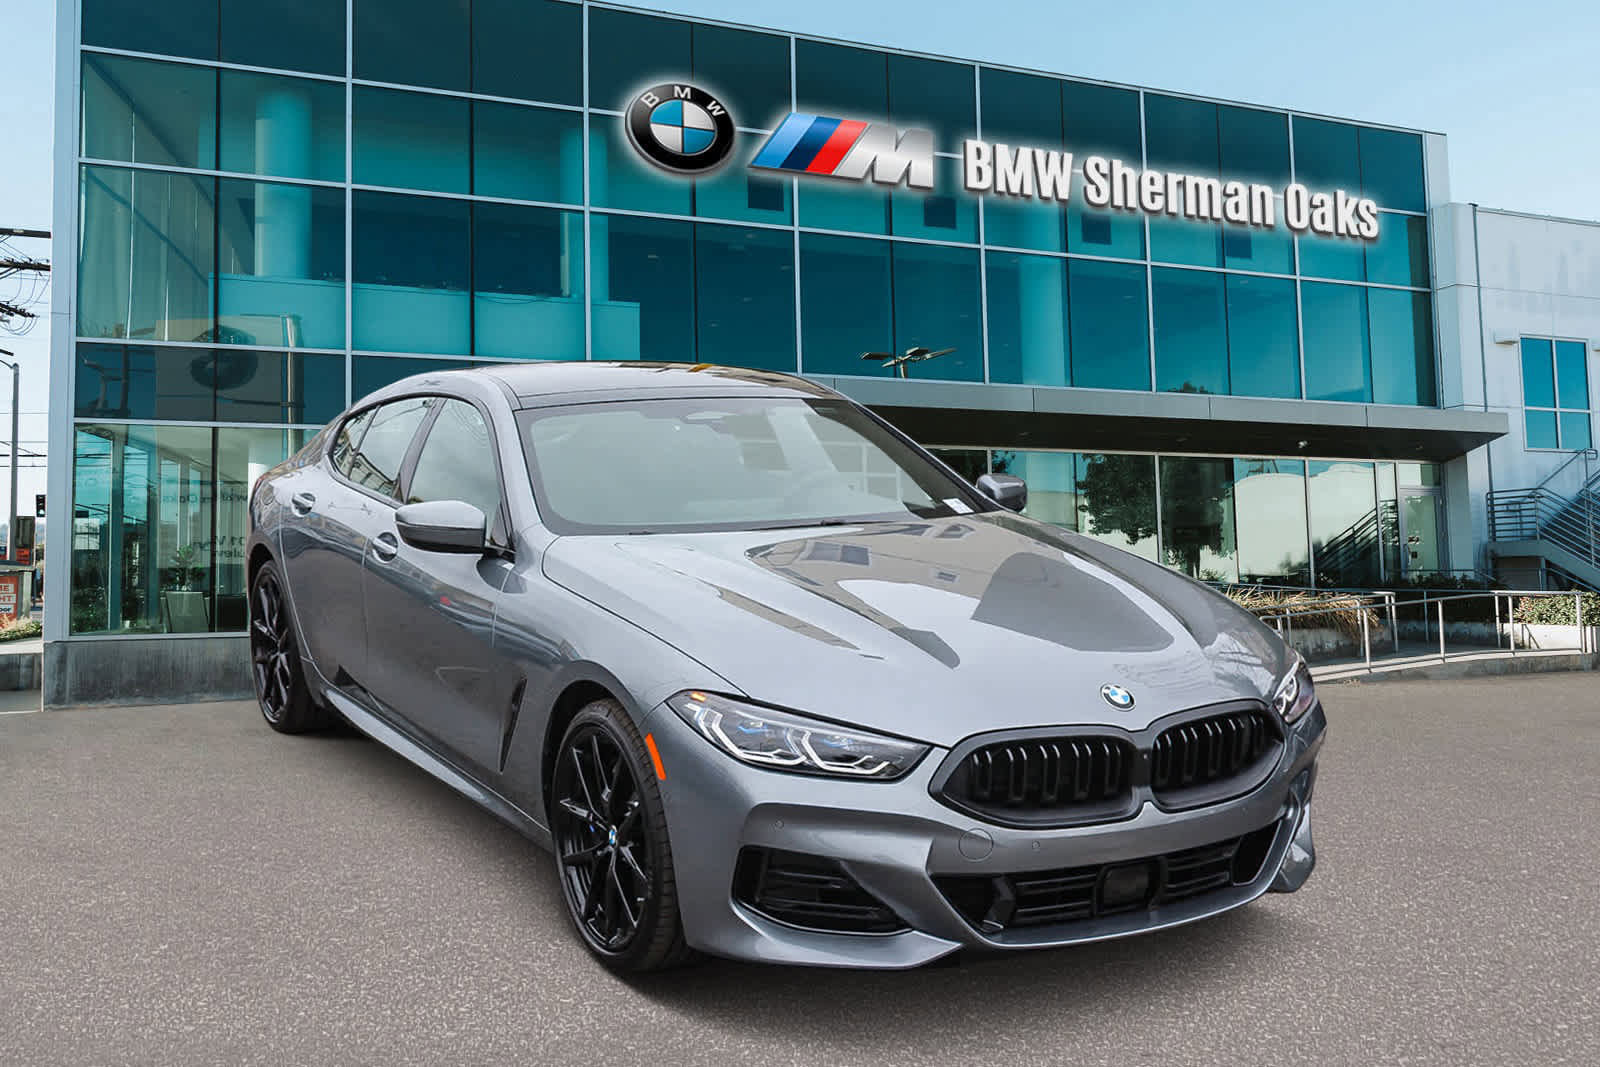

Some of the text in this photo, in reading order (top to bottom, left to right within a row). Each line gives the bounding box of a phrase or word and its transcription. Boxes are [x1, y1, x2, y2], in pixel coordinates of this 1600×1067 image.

[640, 85, 726, 117] BMW
[963, 138, 1379, 240] BMW Sherman Oaks
